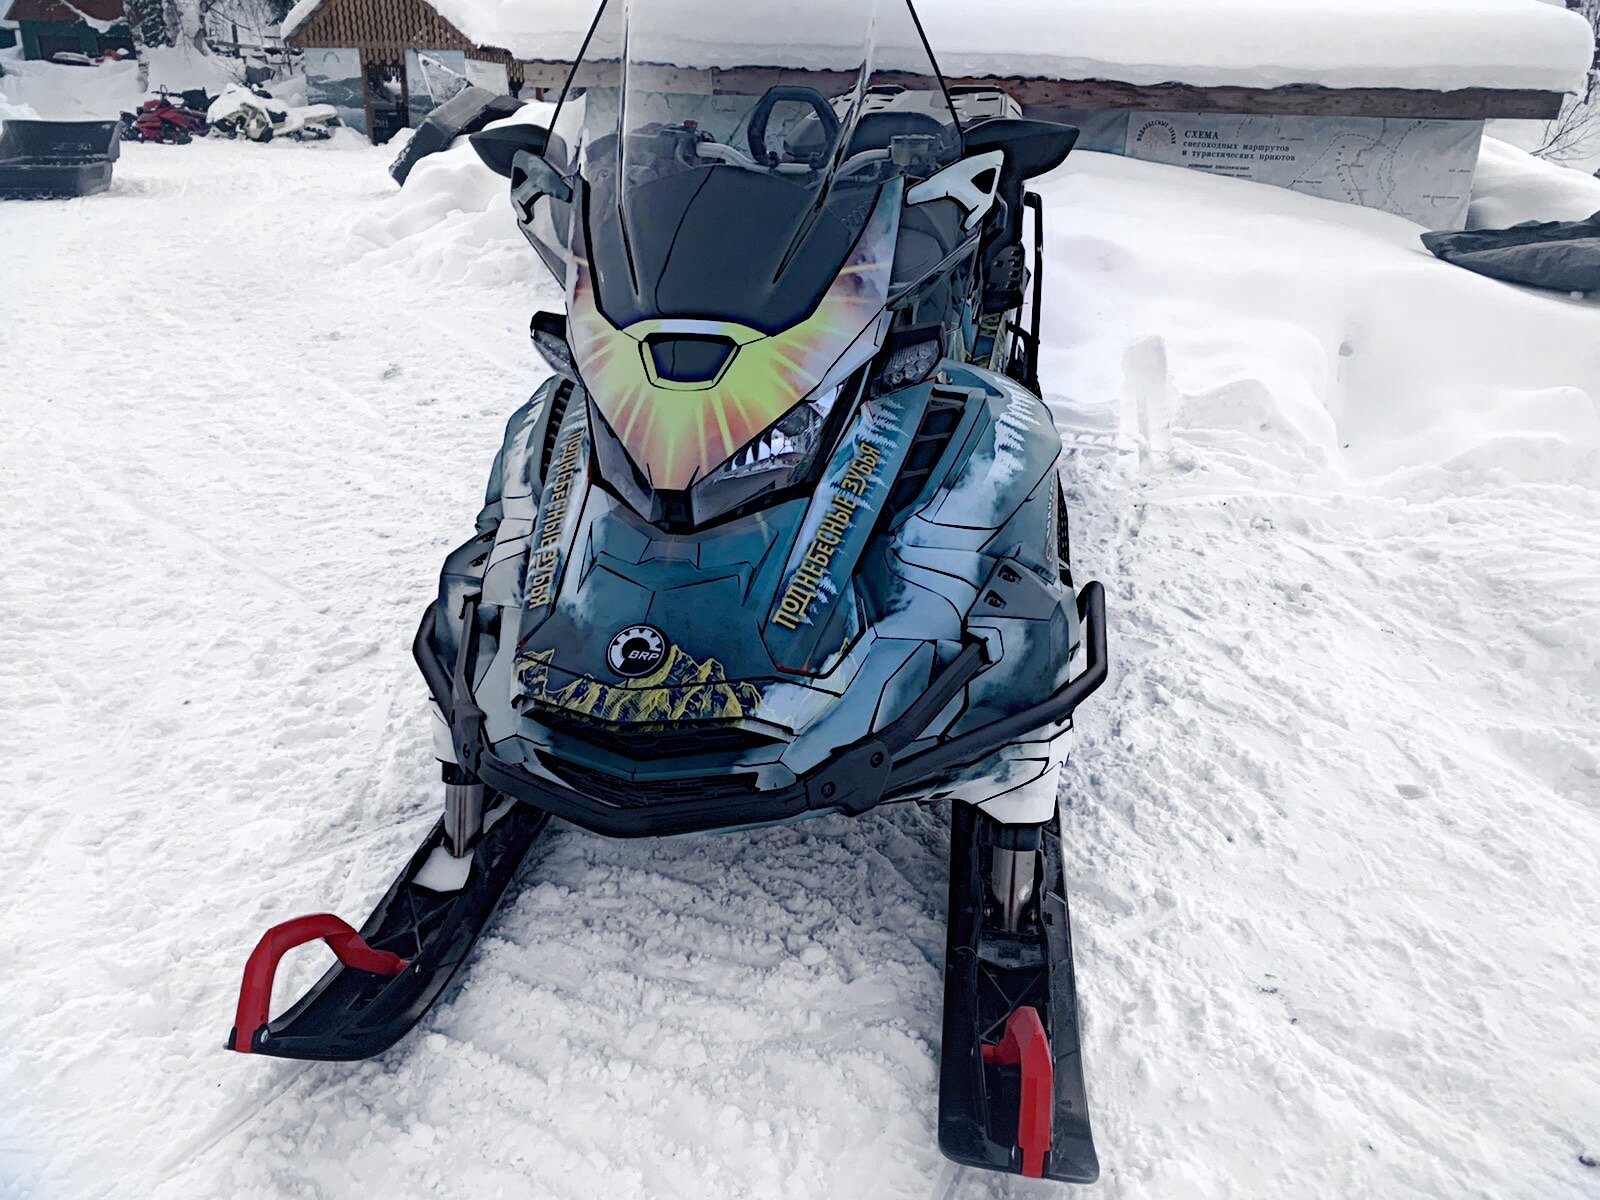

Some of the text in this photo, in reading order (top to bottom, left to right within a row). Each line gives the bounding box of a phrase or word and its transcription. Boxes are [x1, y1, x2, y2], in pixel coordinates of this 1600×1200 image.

[1184, 130, 1219, 140] СХЕМА
[1183, 141, 1290, 153] снегоходных маршрутов
[1191, 151, 1255, 160] туристических
[1259, 154, 1296, 162] приютов
[529, 427, 586, 609] ПОДНЕБЕСНЫЕ ЗУБЬЯ
[772, 441, 881, 630] ПОДНЕБЕСНЫЕ ЗУБЬЯ
[628, 650, 660, 661] BRP
